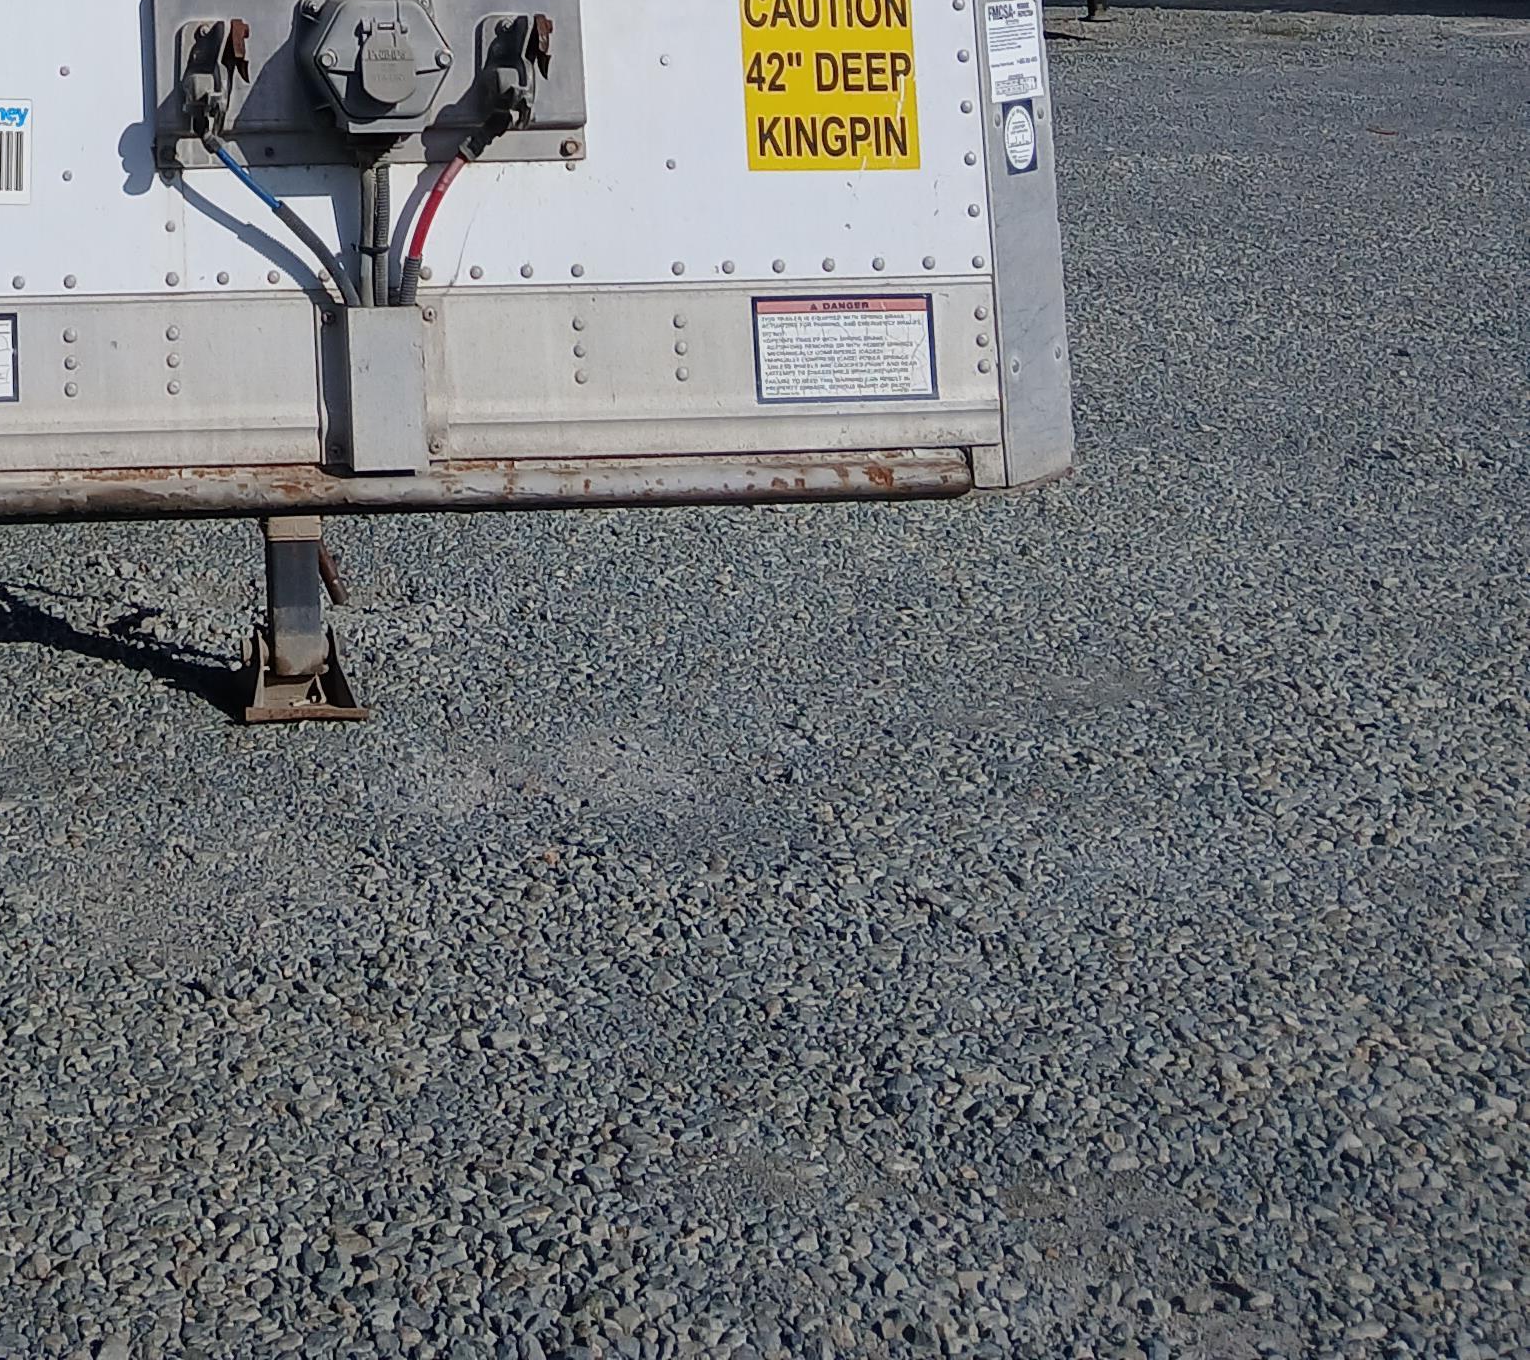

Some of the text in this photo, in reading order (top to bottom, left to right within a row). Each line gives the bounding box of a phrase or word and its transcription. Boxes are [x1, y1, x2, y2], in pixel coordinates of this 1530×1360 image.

[746, 52, 911, 92] 42" DEEP
[758, 117, 908, 157] KINGPIN
[822, 301, 869, 309] DANGER
